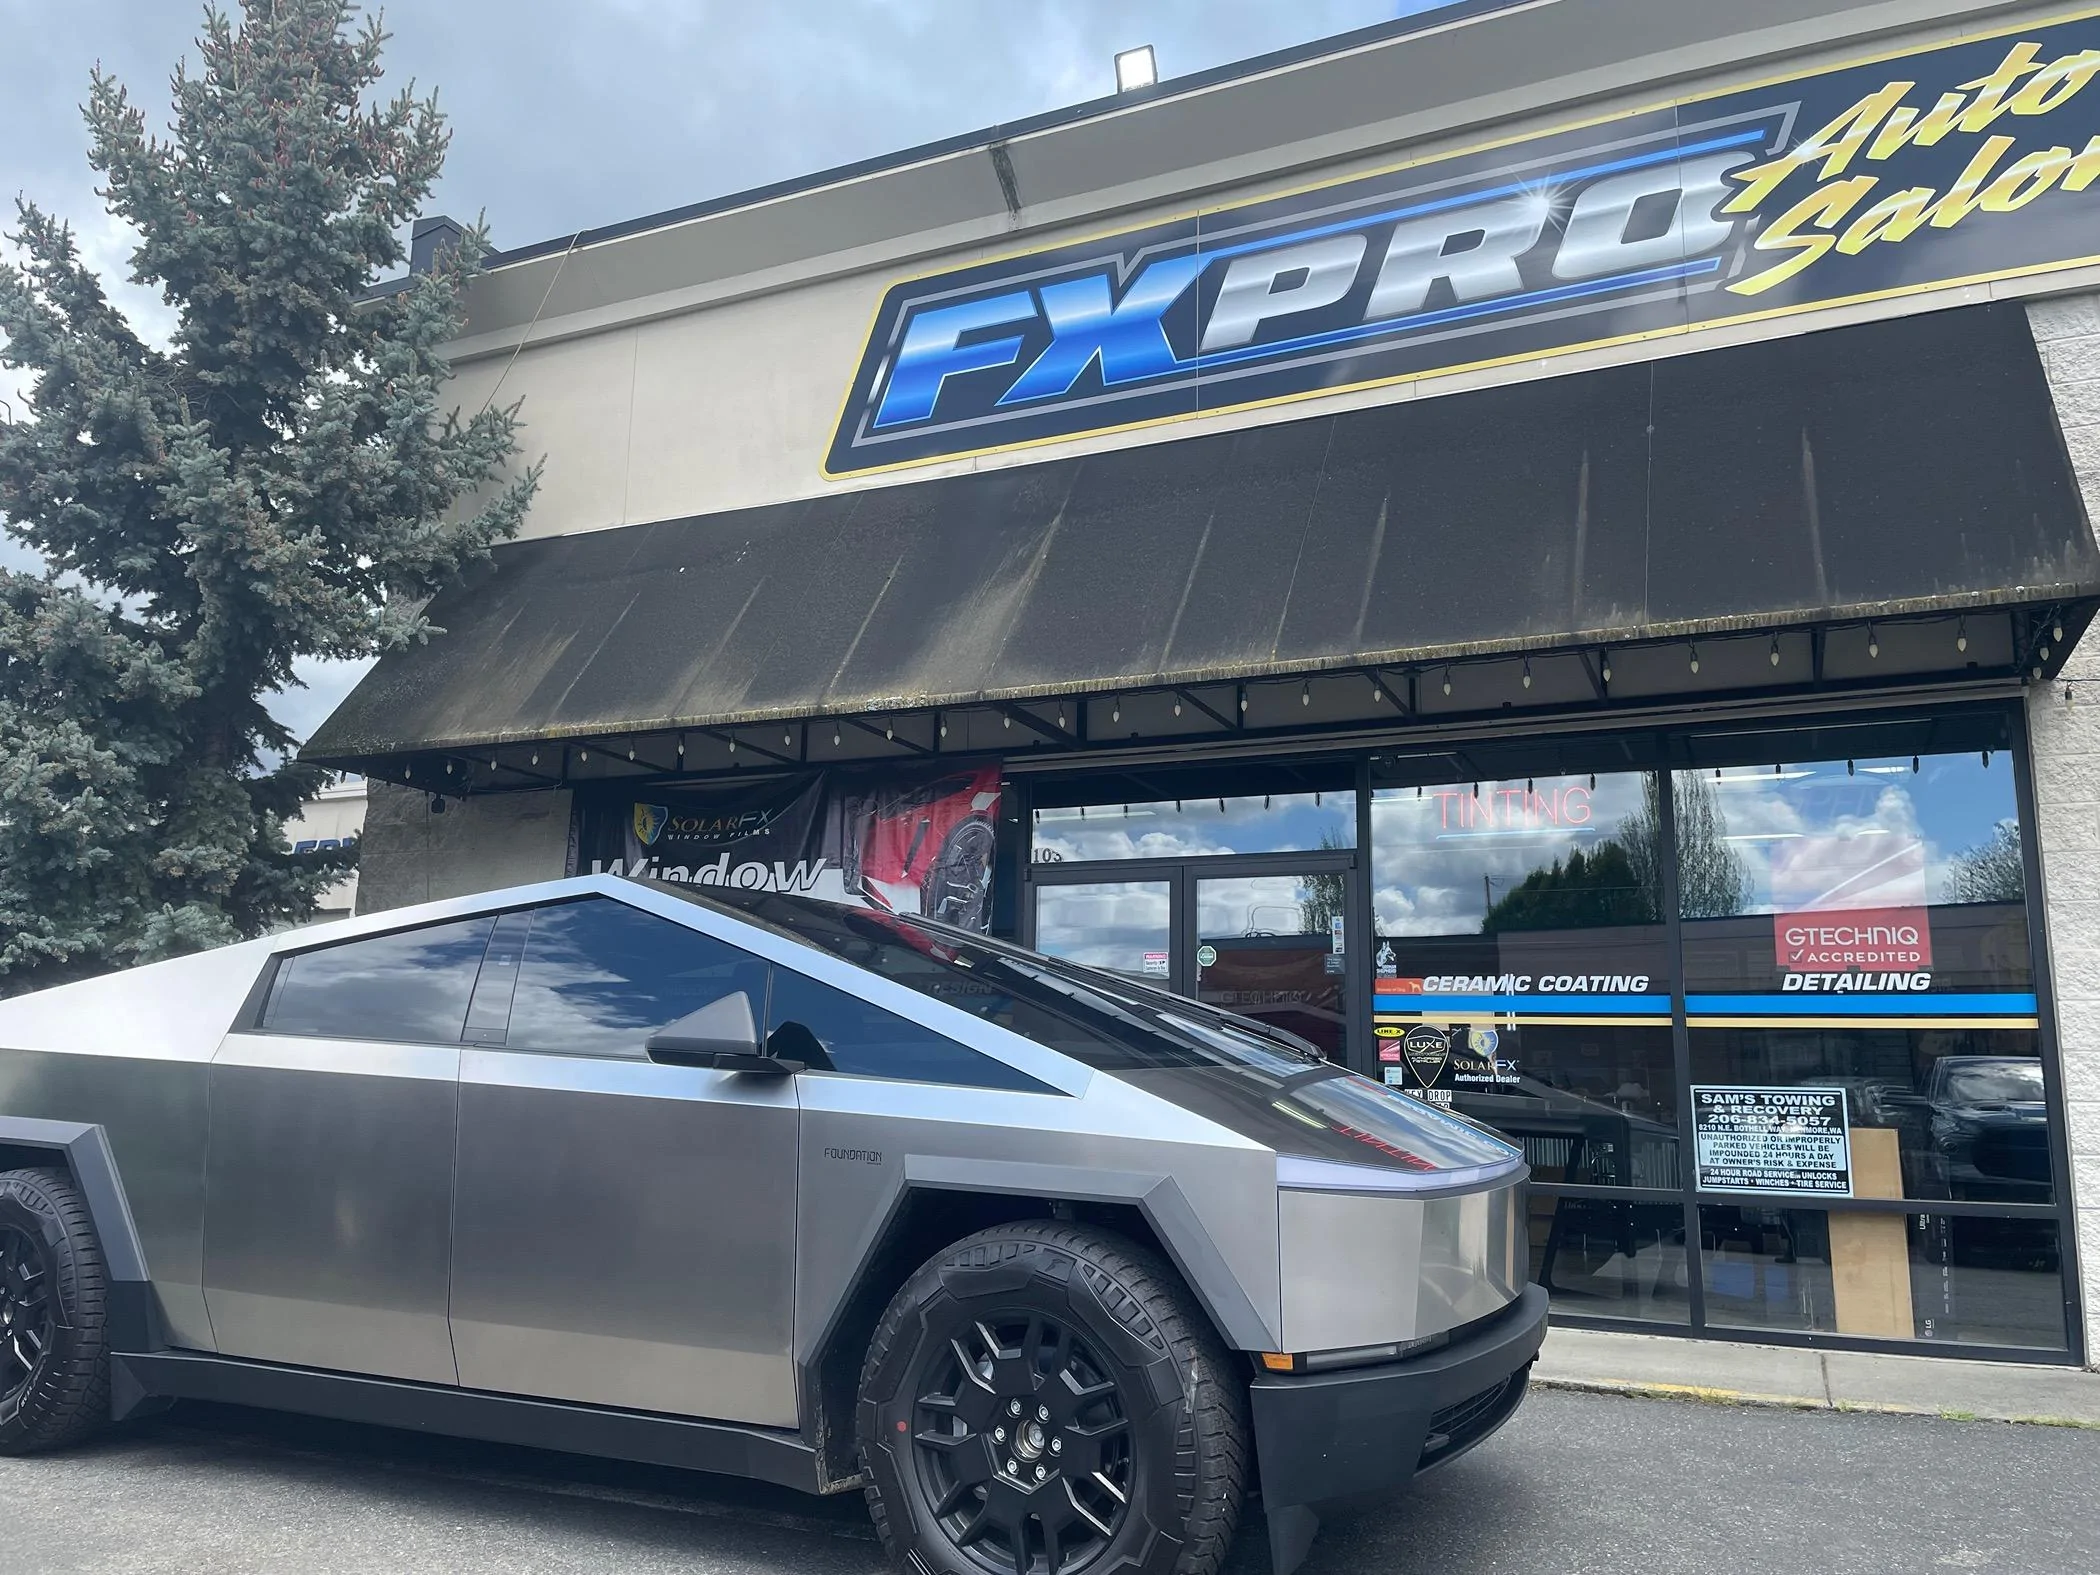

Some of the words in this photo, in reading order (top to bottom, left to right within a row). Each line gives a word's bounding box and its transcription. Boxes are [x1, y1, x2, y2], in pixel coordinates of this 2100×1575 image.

[1720, 41, 2100, 213] Auto
[1432, 787, 1591, 829] TINTING
[668, 808, 773, 832] SOLARFX
[730, 828, 770, 838] FILMS
[592, 853, 827, 892] Window
[1785, 927, 1920, 945] GTECHNIQ
[1807, 951, 1921, 963] ACCREDITED
[1422, 975, 1532, 992] CERAMIC
[1538, 975, 1650, 992] COATING
[1781, 973, 1932, 991] DETAILING
[1410, 1041, 1443, 1050] LUXE
[1453, 1059, 1517, 1071] SOLARFX
[1454, 1073, 1494, 1082] Authorized
[1496, 1075, 1521, 1083] Dealer
[1429, 1091, 1451, 1100] DROP
[1701, 1093, 1756, 1104] SAM'S
[1760, 1095, 1836, 1106] TOWING
[1713, 1105, 1725, 1113] &
[1731, 1105, 1823, 1115] RECOVERY
[1708, 1114, 1832, 1126] 206-834-5057
[1701, 1133, 1768, 1142] UNAUTHORIZED
[1786, 1136, 1841, 1144] IMPROPERLY
[1749, 1142, 1791, 1150] VEHICLES
[824, 1148, 882, 1162] FOUNDATION
[1709, 1149, 1760, 1157] IMPOUNDED
[1722, 1158, 1761, 1166] OWNER'S
[1801, 1172, 1837, 1180] UNLOCKS
[1702, 1176, 1750, 1185] JUMPSTARTS
[1755, 1179, 1792, 1187] WINCHES
[1815, 1180, 1847, 1189] SERVICE
[1925, 1320, 1932, 1328] LG
